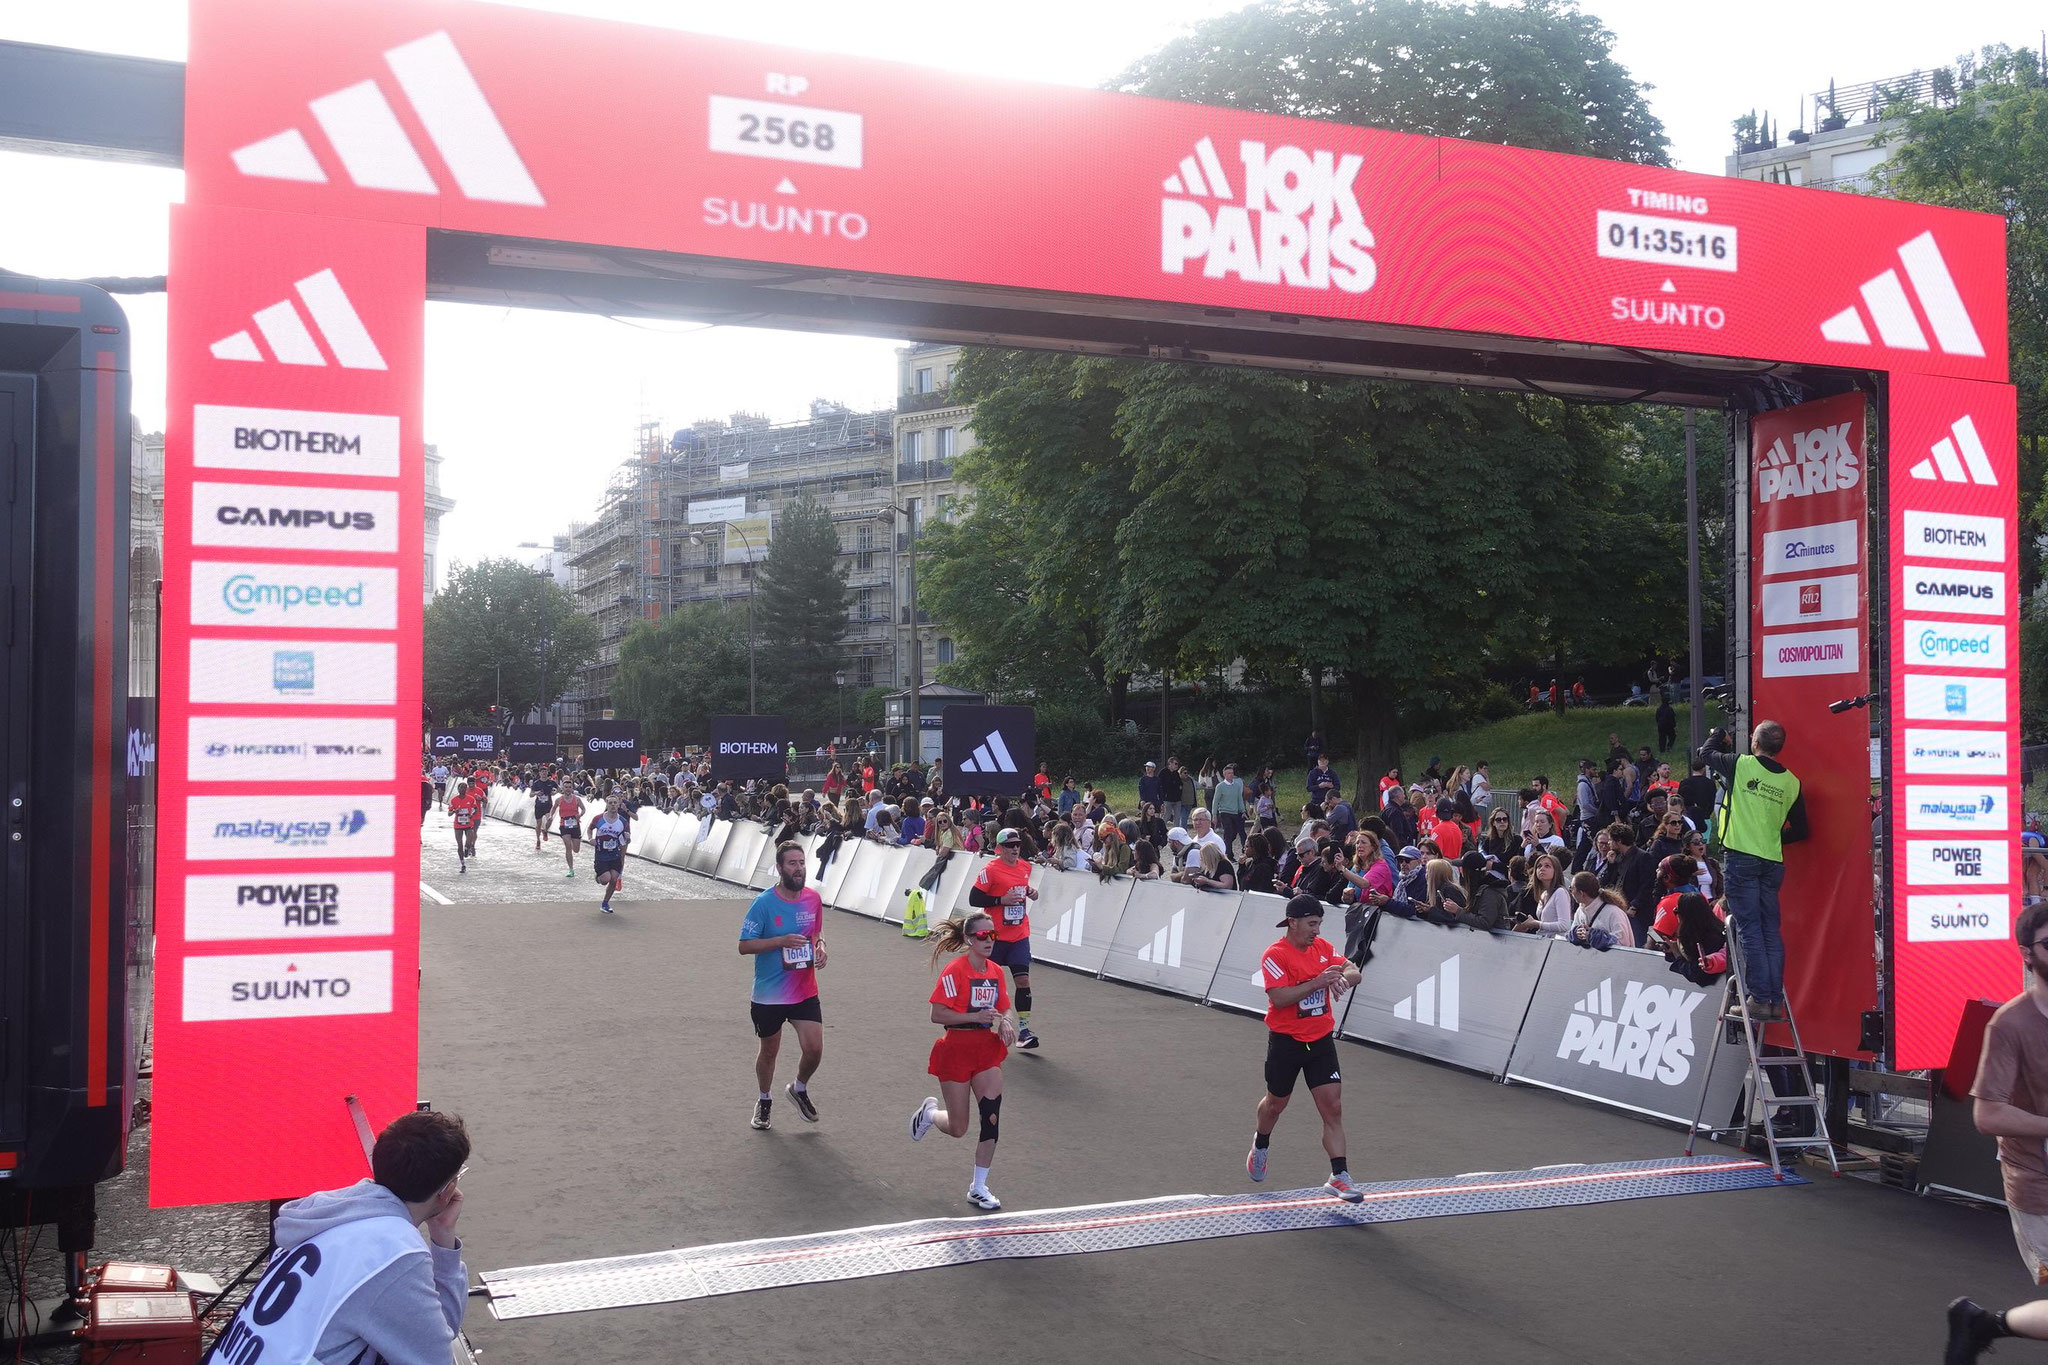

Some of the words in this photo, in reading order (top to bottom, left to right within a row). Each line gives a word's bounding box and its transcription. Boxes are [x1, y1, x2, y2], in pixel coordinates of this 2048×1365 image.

[765, 71, 809, 96] RP
[737, 113, 835, 151] 2568
[1239, 138, 1366, 222] 10K
[1626, 187, 1709, 215] TIMING
[702, 196, 869, 241] SUUNTO
[1161, 197, 1378, 294] PARIS
[1608, 222, 1727, 260] 01:35:16
[1610, 296, 1726, 330] SUUNTO
[234, 426, 361, 455] BIOTHERM
[1792, 421, 1853, 465] 10K
[1759, 454, 1860, 504] PARIS
[216, 505, 376, 531] CAMPUS
[1923, 526, 1987, 548] BIOTHERM
[222, 573, 364, 615] Compeed
[1801, 591, 1820, 605] RTL2
[1915, 580, 1994, 600] CAMPUS
[1778, 643, 1844, 664] COSMOPOLITAN
[1919, 628, 1990, 658] Compeed
[463, 734, 494, 742] POWER
[476, 741, 494, 749] ADE
[588, 737, 635, 752] Compeed
[719, 741, 778, 755] BIOTHERM
[1920, 800, 1978, 818] malaysia
[213, 819, 332, 843] malaysia
[1932, 848, 1982, 862] POWER
[1954, 863, 1982, 877] ADE
[237, 883, 340, 907] POWER
[283, 904, 340, 927] ADE
[1930, 913, 1990, 929] SUUNTO
[786, 949, 808, 960] 16146
[231, 977, 351, 1002] SUUNTO
[974, 988, 995, 1001] 18477
[1617, 980, 1707, 1036] 10K
[1556, 1012, 1695, 1086] PARIS
